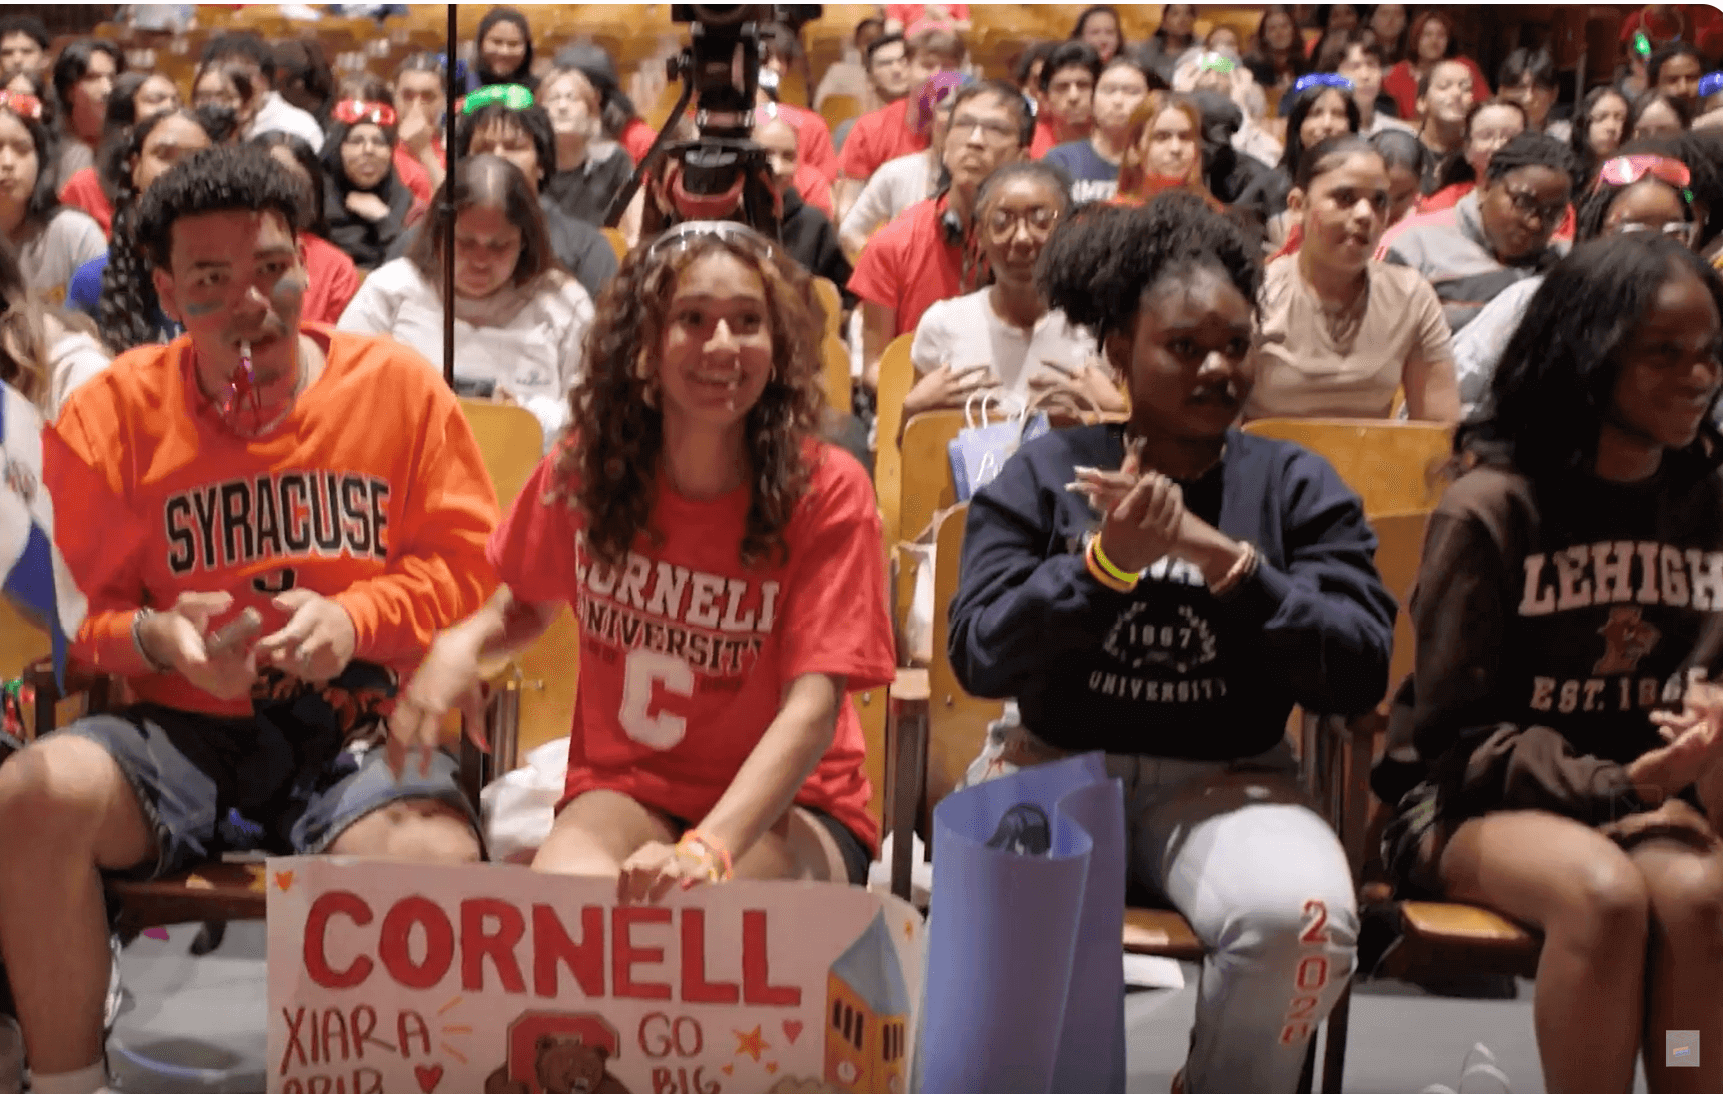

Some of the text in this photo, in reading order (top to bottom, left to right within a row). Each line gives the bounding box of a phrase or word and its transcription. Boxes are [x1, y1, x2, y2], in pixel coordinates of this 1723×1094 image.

[164, 468, 391, 577] SYRACUSE
[1518, 540, 1723, 617] LEHIGH
[577, 593, 763, 676] NIVERSIT
[618, 650, 695, 752] C
[1530, 676, 1606, 713] EST.
[303, 890, 802, 1006] CORNELL
[279, 1004, 432, 1076] XIARA
[638, 1011, 704, 1059] GO
